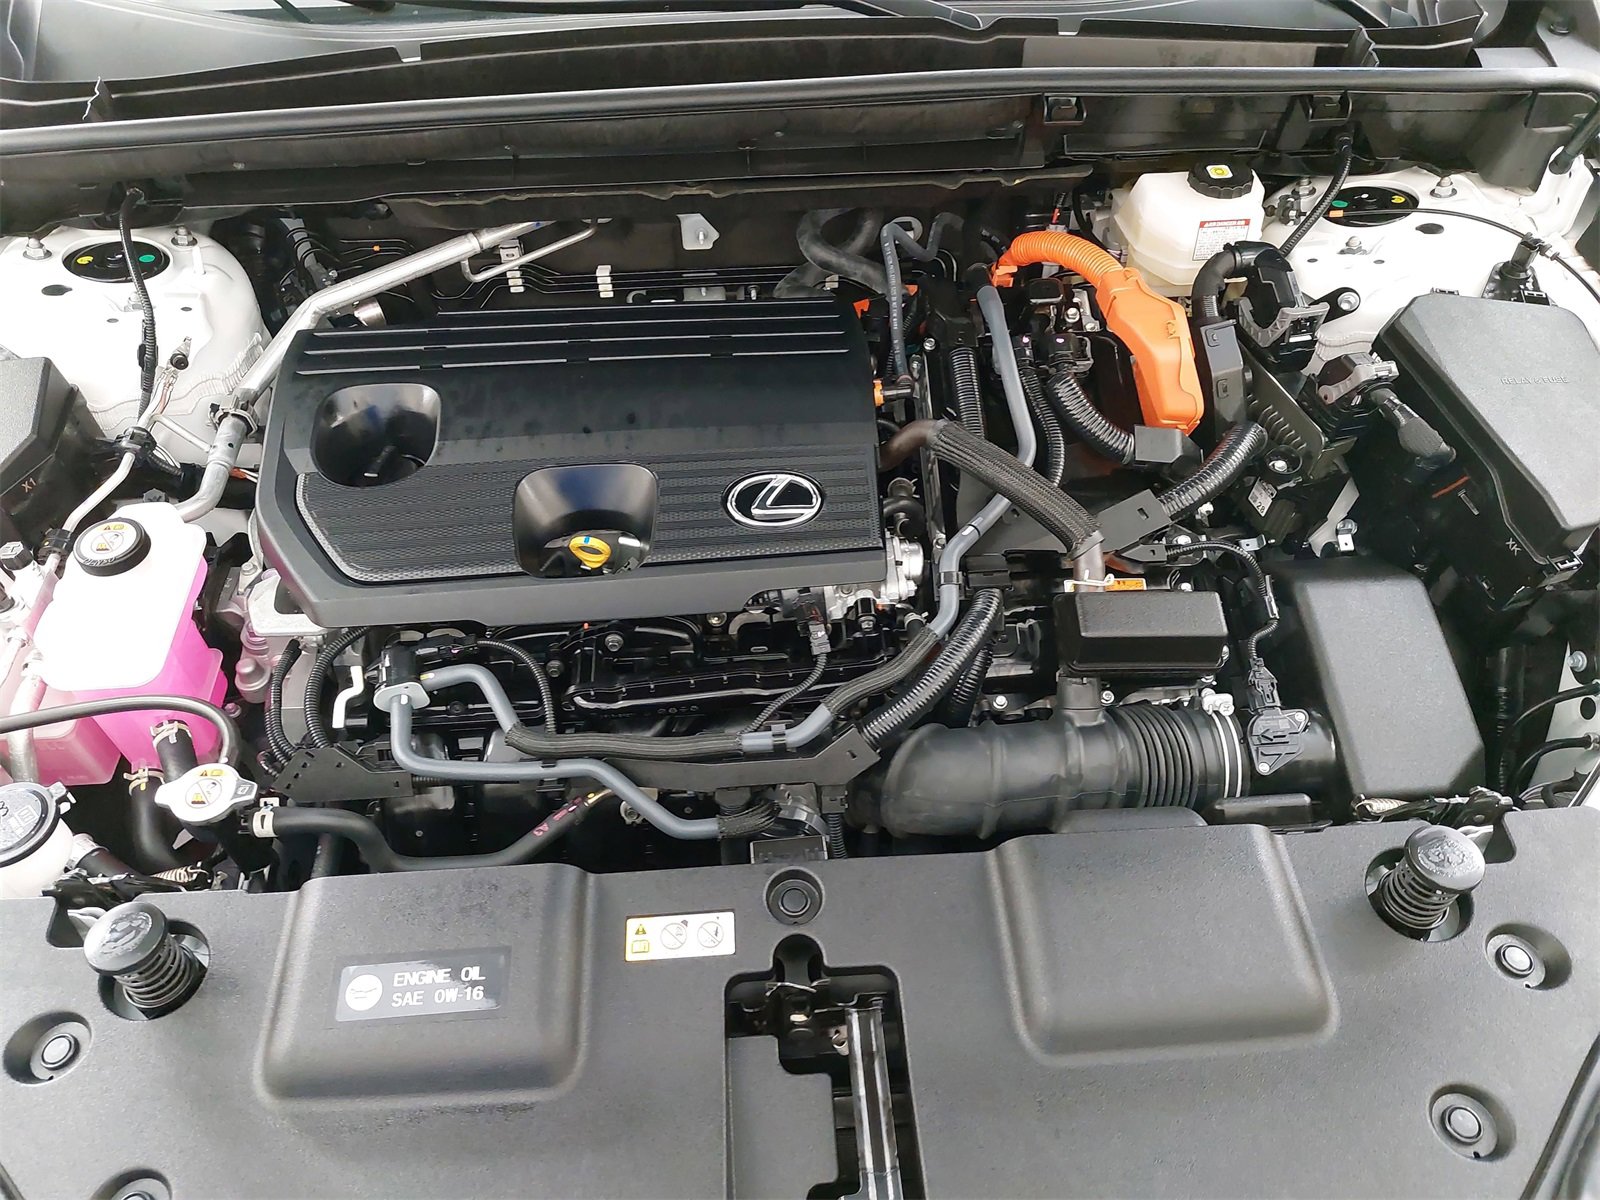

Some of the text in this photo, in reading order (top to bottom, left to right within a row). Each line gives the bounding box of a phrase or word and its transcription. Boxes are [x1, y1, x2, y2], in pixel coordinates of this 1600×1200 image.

[1500, 376, 1531, 384] RELAY
[393, 966, 486, 987] ENGINE OIL
[391, 985, 485, 1008] SAE 0W-16
